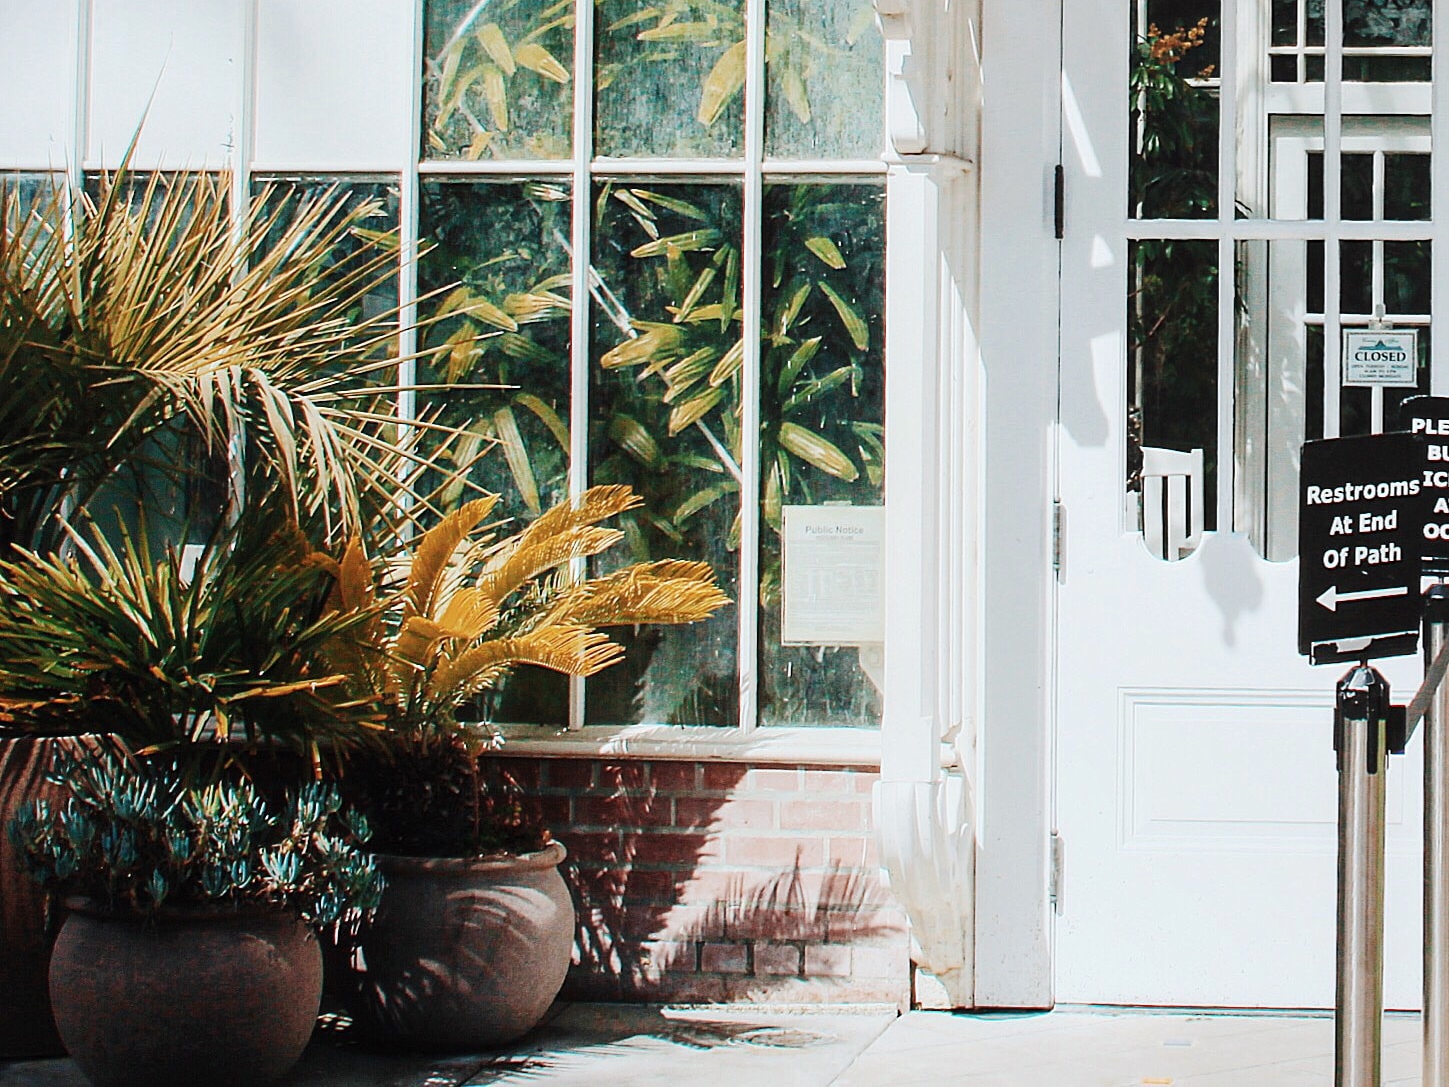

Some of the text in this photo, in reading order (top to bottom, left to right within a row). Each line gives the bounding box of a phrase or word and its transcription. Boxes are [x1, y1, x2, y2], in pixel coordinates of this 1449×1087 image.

[1354, 351, 1406, 362] CLOSED
[1307, 479, 1420, 505] Restrooms
[805, 525, 864, 535] Public Notice
[1329, 510, 1397, 536] At End
[1323, 543, 1401, 569] Of Path
